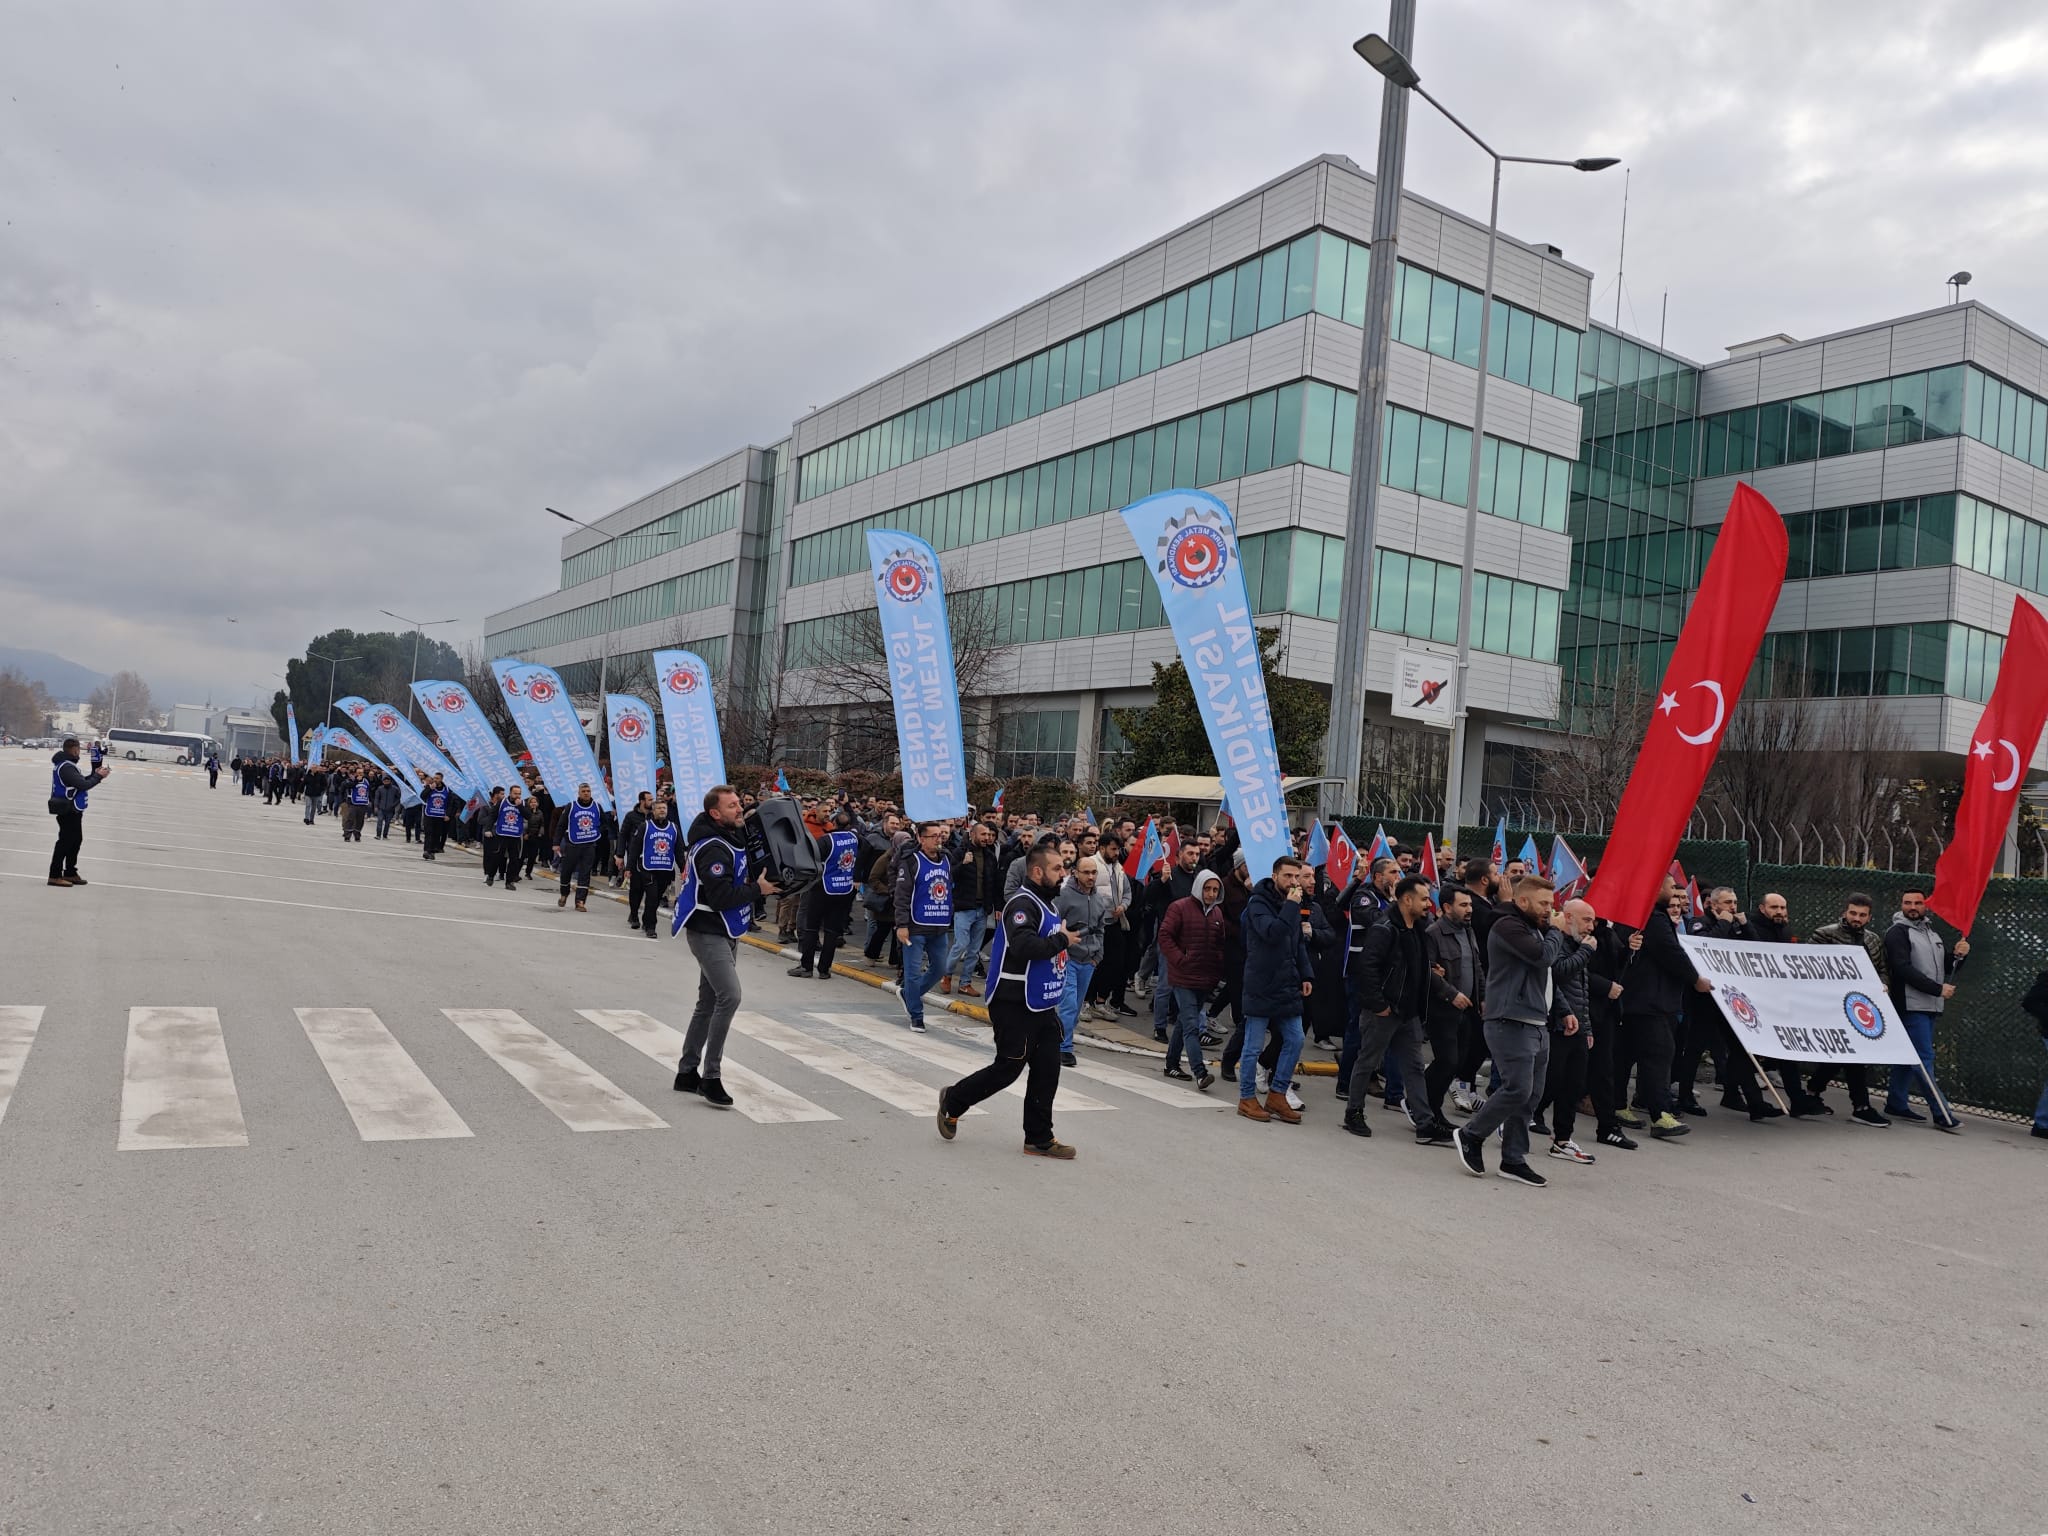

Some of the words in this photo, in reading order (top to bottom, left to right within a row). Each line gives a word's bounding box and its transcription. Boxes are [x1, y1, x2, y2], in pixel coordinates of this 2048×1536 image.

[1694, 942, 1740, 976] TÜRK
[1734, 951, 1788, 979] METAL
[1772, 1025, 1819, 1054] EMEK
[1811, 1027, 1857, 1059] ŞUBE
